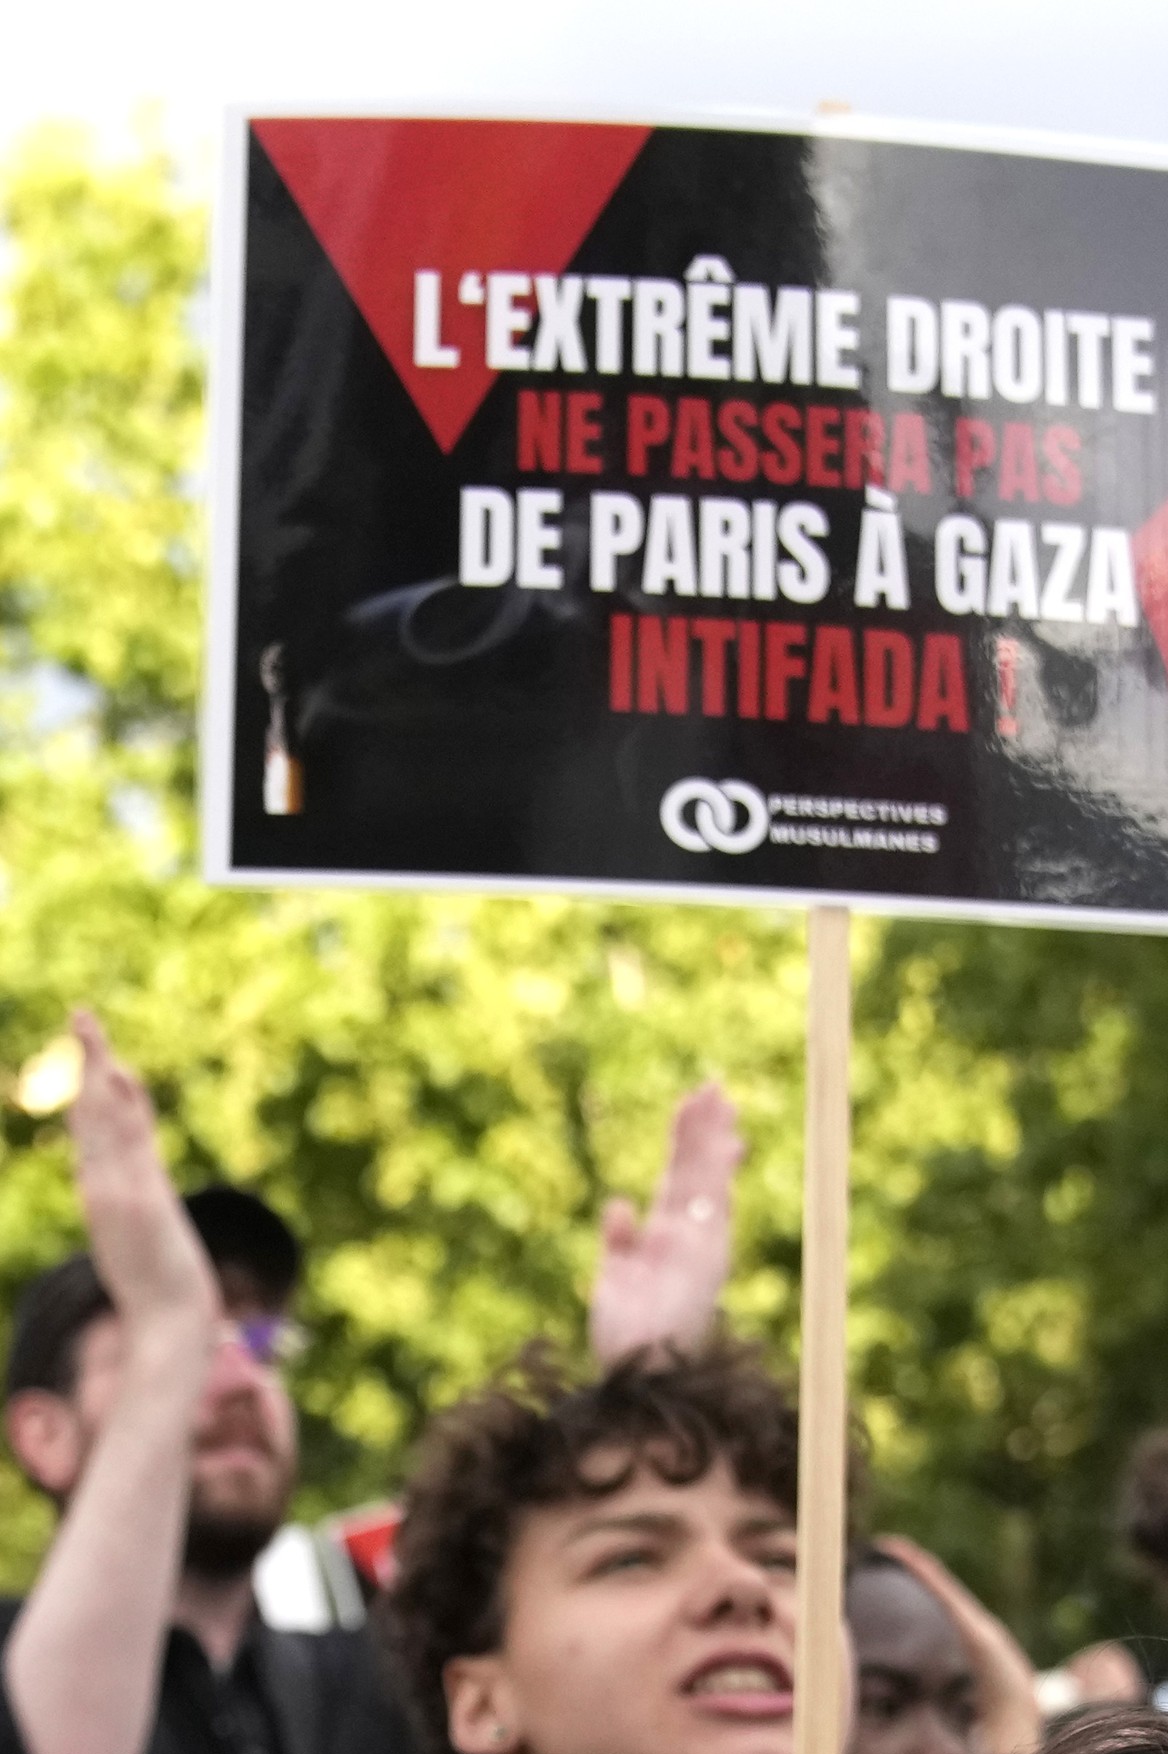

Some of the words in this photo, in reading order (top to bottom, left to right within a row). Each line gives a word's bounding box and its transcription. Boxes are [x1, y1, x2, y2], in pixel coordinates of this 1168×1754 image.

[886, 295, 1156, 415] DROITE
[517, 390, 602, 474] NE
[627, 395, 931, 495] PASSERA
[955, 418, 1083, 505] PAS
[459, 486, 563, 590] DE
[589, 492, 831, 603] PARIS
[854, 483, 910, 610] À
[934, 514, 1139, 627] GAZA
[609, 613, 969, 734] INTIFADA
[995, 637, 1018, 736] !
[768, 793, 947, 826] PERSPECTIVES
[769, 823, 940, 854] MUSULMANES
